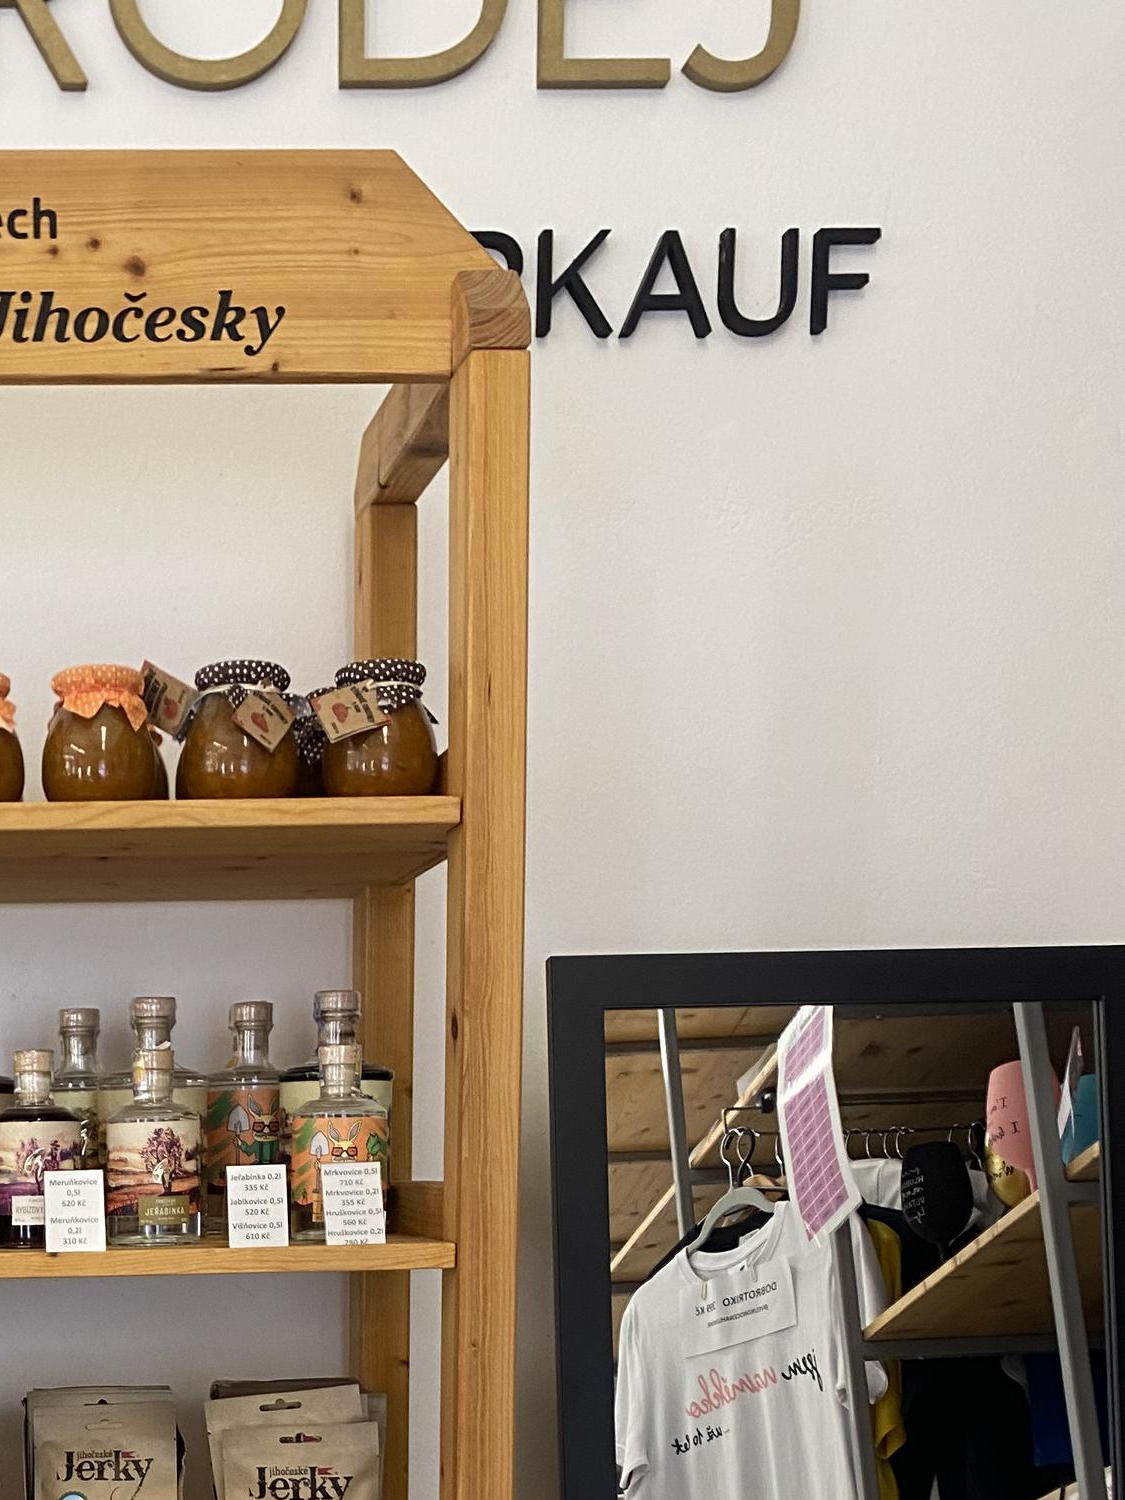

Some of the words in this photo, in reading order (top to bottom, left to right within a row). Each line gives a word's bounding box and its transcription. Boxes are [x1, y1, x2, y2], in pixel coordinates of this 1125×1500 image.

[325, 1168, 362, 1176] Mrkvovice
[49, 1178, 97, 1186] Meruňkovice
[354, 1178, 364, 1186] Kč
[259, 1183, 269, 1191] Kč
[325, 1188, 364, 1196] Mrkvovice
[77, 1199, 87, 1207] Kč
[230, 1197, 268, 1206] Jablkovice
[245, 1208, 259, 1216] 520
[260, 1208, 270, 1216] Kč
[326, 1208, 367, 1217] Hruškovice
[50, 1216, 99, 1224] Meruňkovice
[232, 1221, 267, 1230] Višňovice
[245, 1232, 260, 1240] 610
[327, 1228, 369, 1237] Hruškovice
[78, 1237, 88, 1245] Kč
